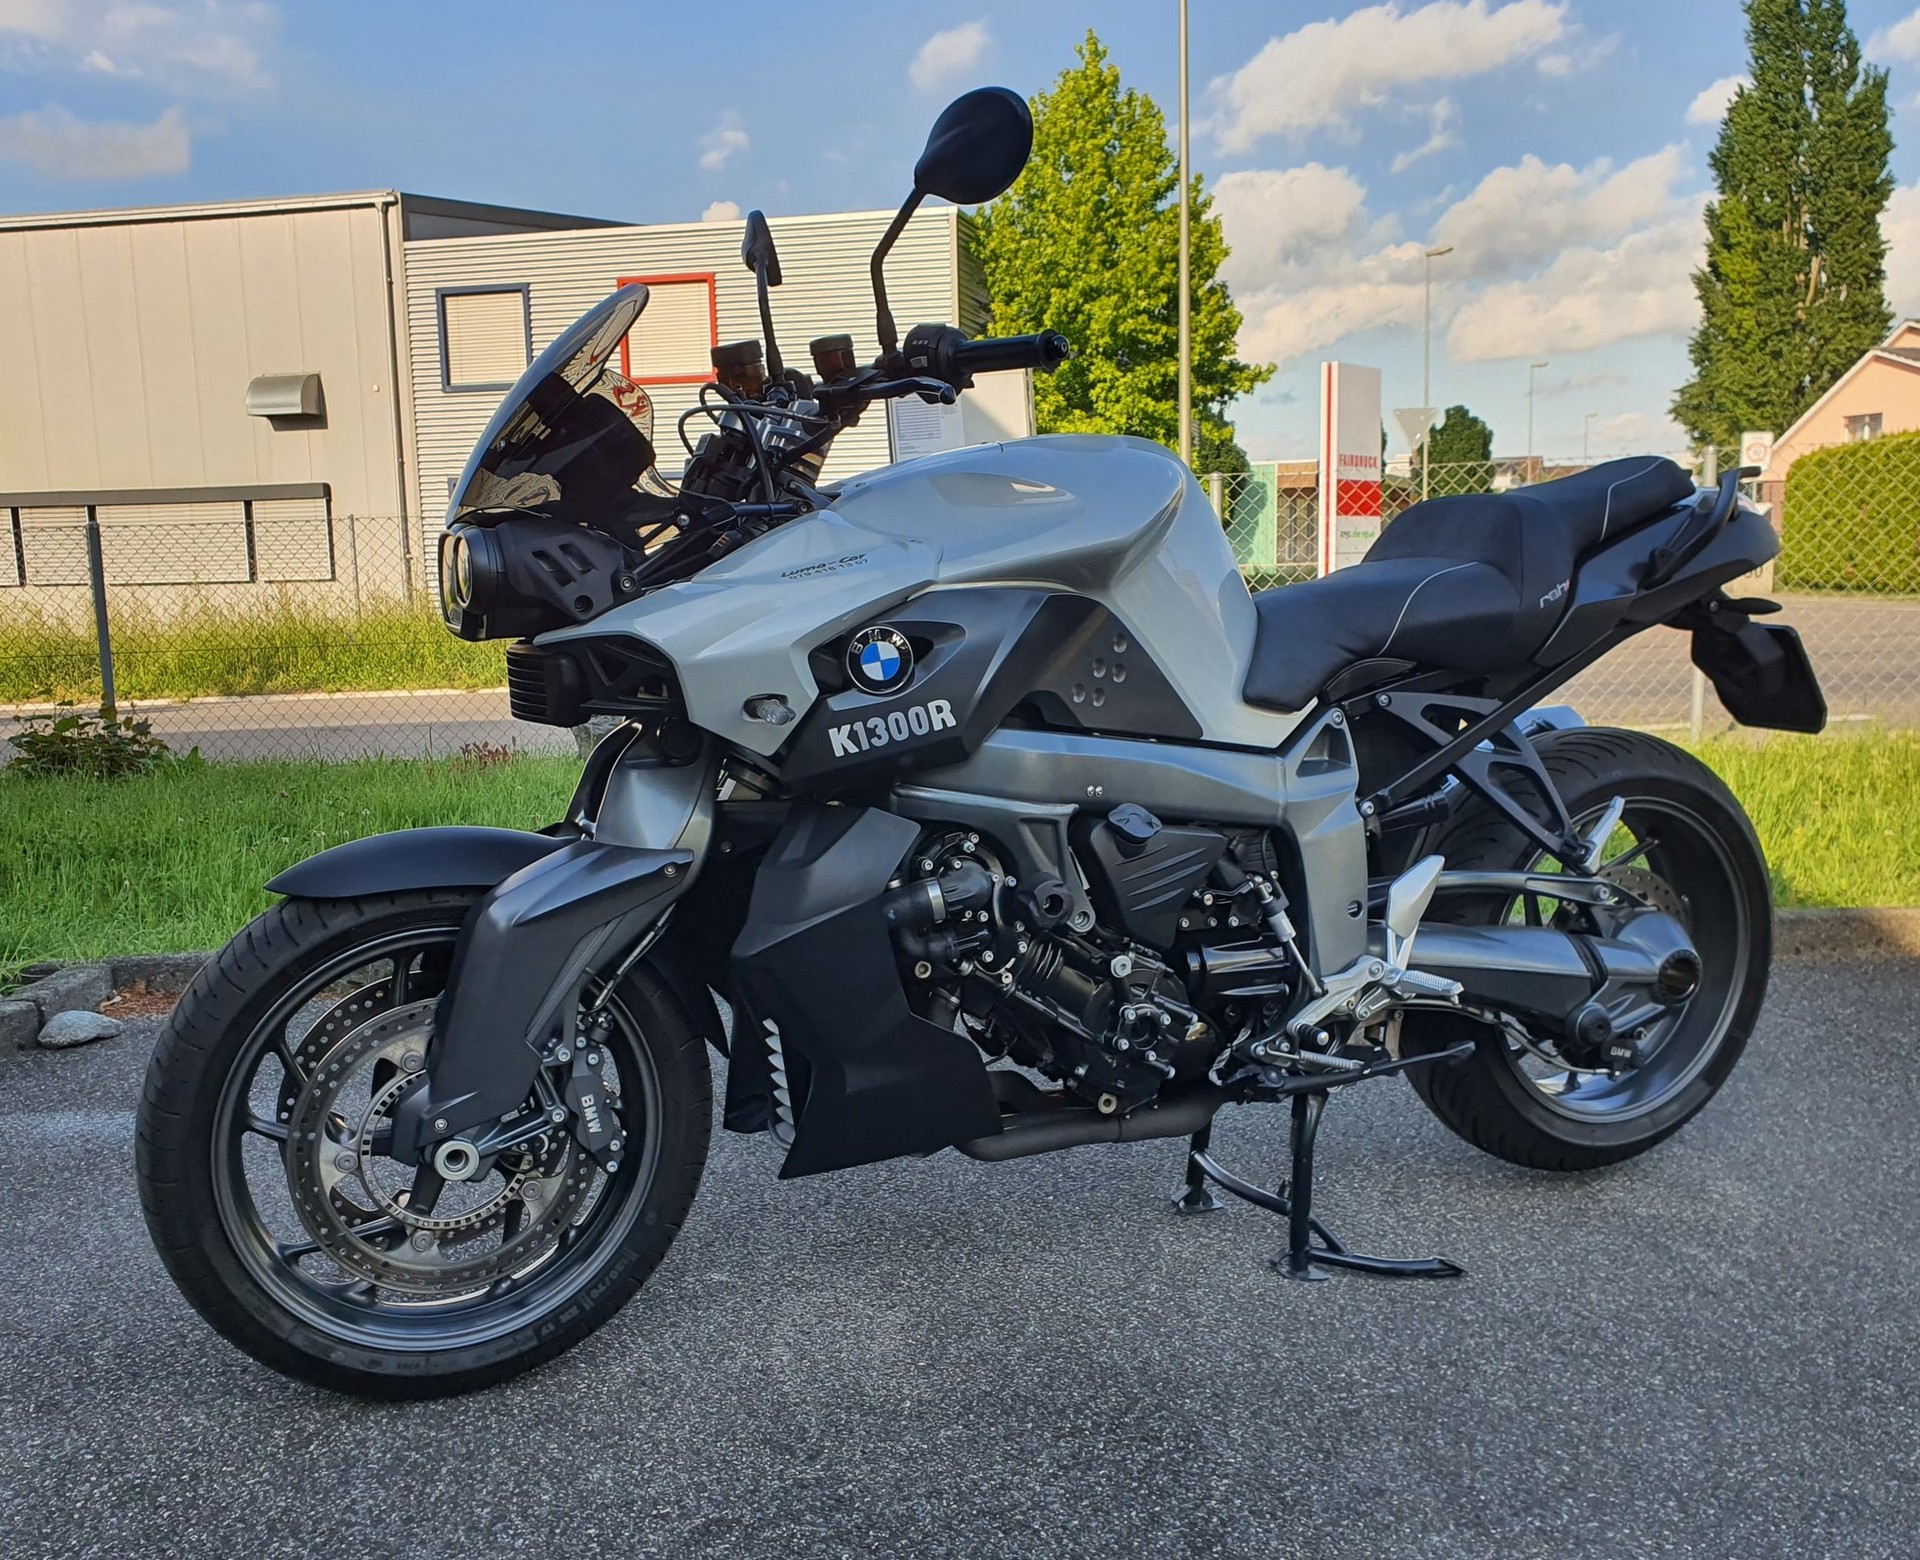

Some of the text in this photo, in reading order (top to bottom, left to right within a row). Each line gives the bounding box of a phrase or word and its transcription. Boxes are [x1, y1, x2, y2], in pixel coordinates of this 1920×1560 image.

[850, 628, 909, 655] BMW
[828, 699, 957, 758] K1300R
[1610, 1046, 1632, 1058] BMW
[581, 1094, 602, 1133] BMW
